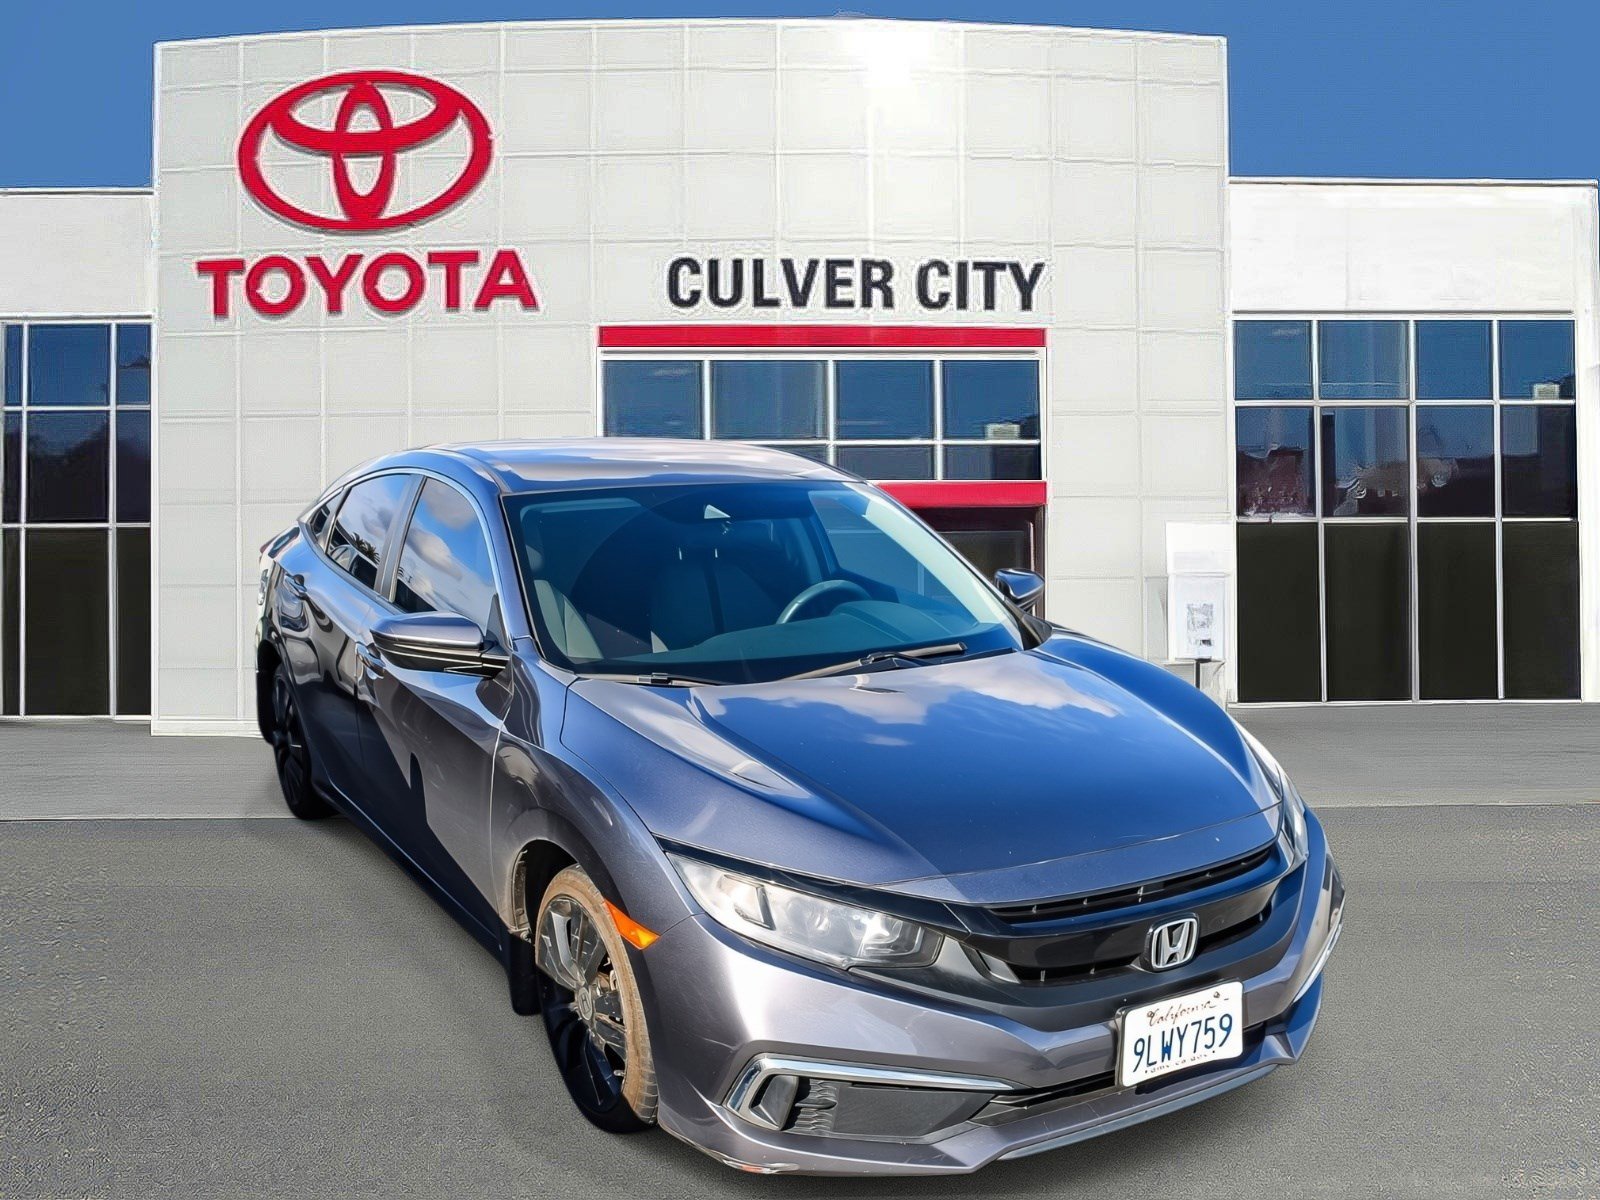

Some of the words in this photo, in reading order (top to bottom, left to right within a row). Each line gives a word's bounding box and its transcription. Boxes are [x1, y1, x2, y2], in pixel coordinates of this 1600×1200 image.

[196, 249, 539, 318] TOYOTA
[667, 257, 896, 309] CULVER
[915, 259, 1046, 311] CITY
[1132, 1013, 1233, 1073] 9LWY759
